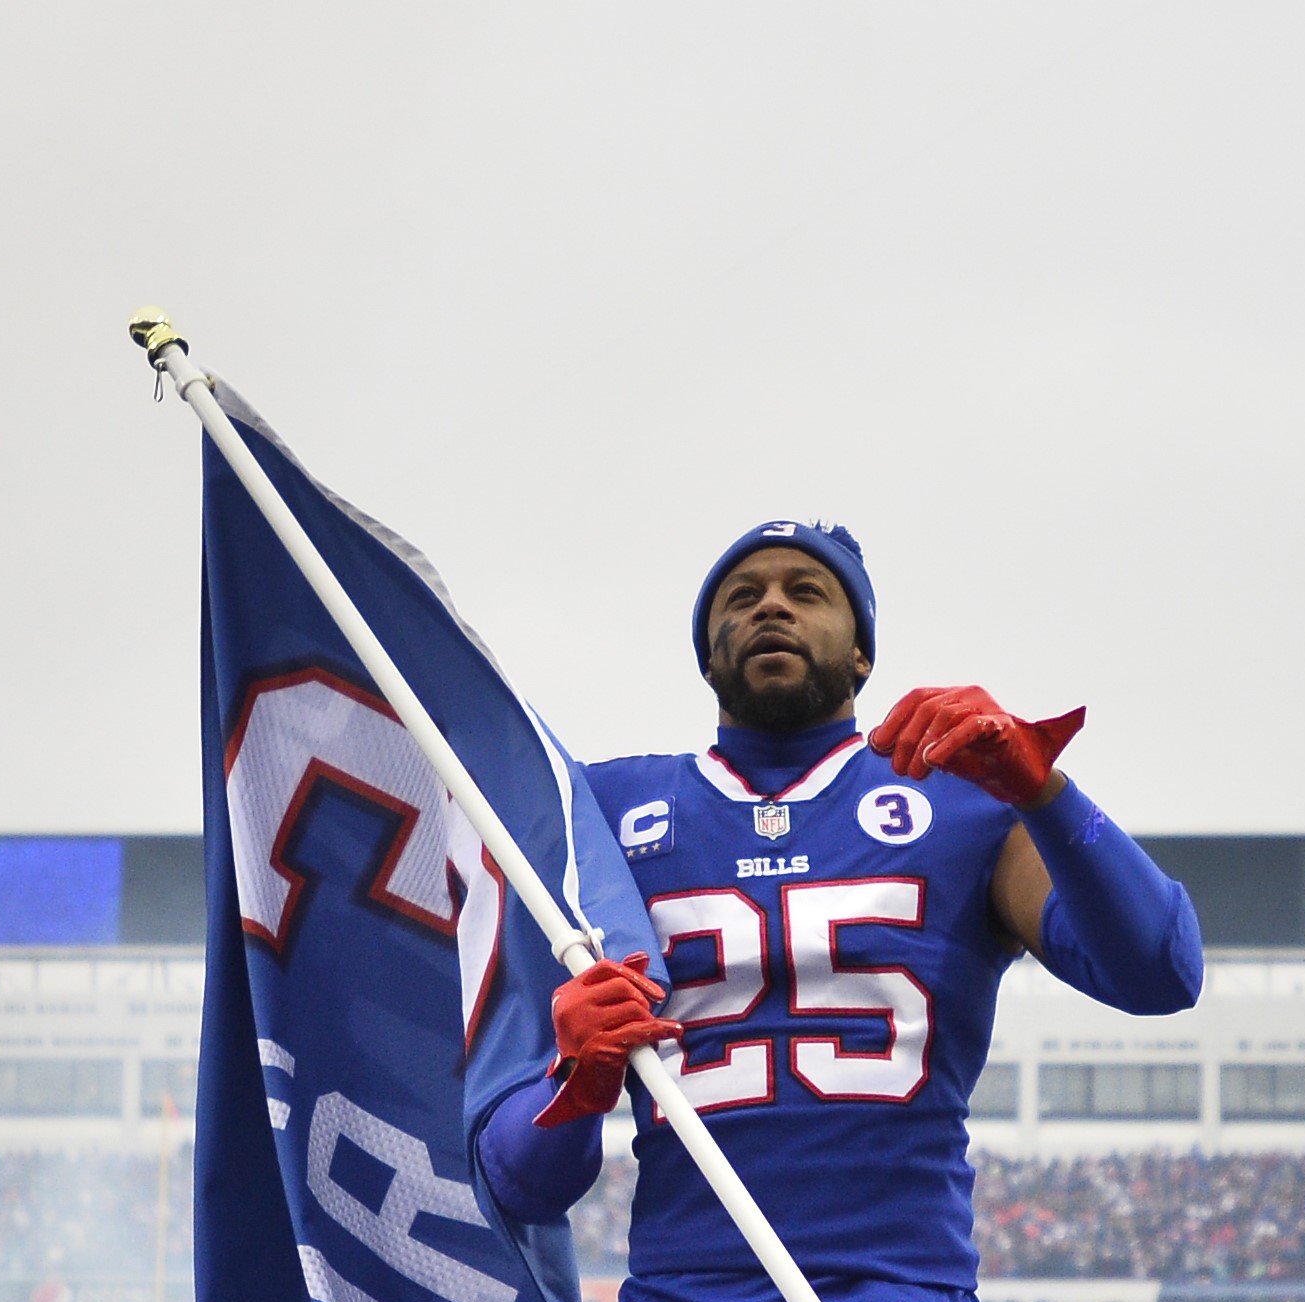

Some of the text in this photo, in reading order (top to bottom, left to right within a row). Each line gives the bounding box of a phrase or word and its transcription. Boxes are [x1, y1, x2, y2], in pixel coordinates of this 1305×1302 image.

[618, 799, 671, 848] C
[760, 817, 785, 832] NFL
[874, 792, 915, 838] 3
[737, 855, 810, 879] BILLS
[646, 876, 935, 1125] 25
